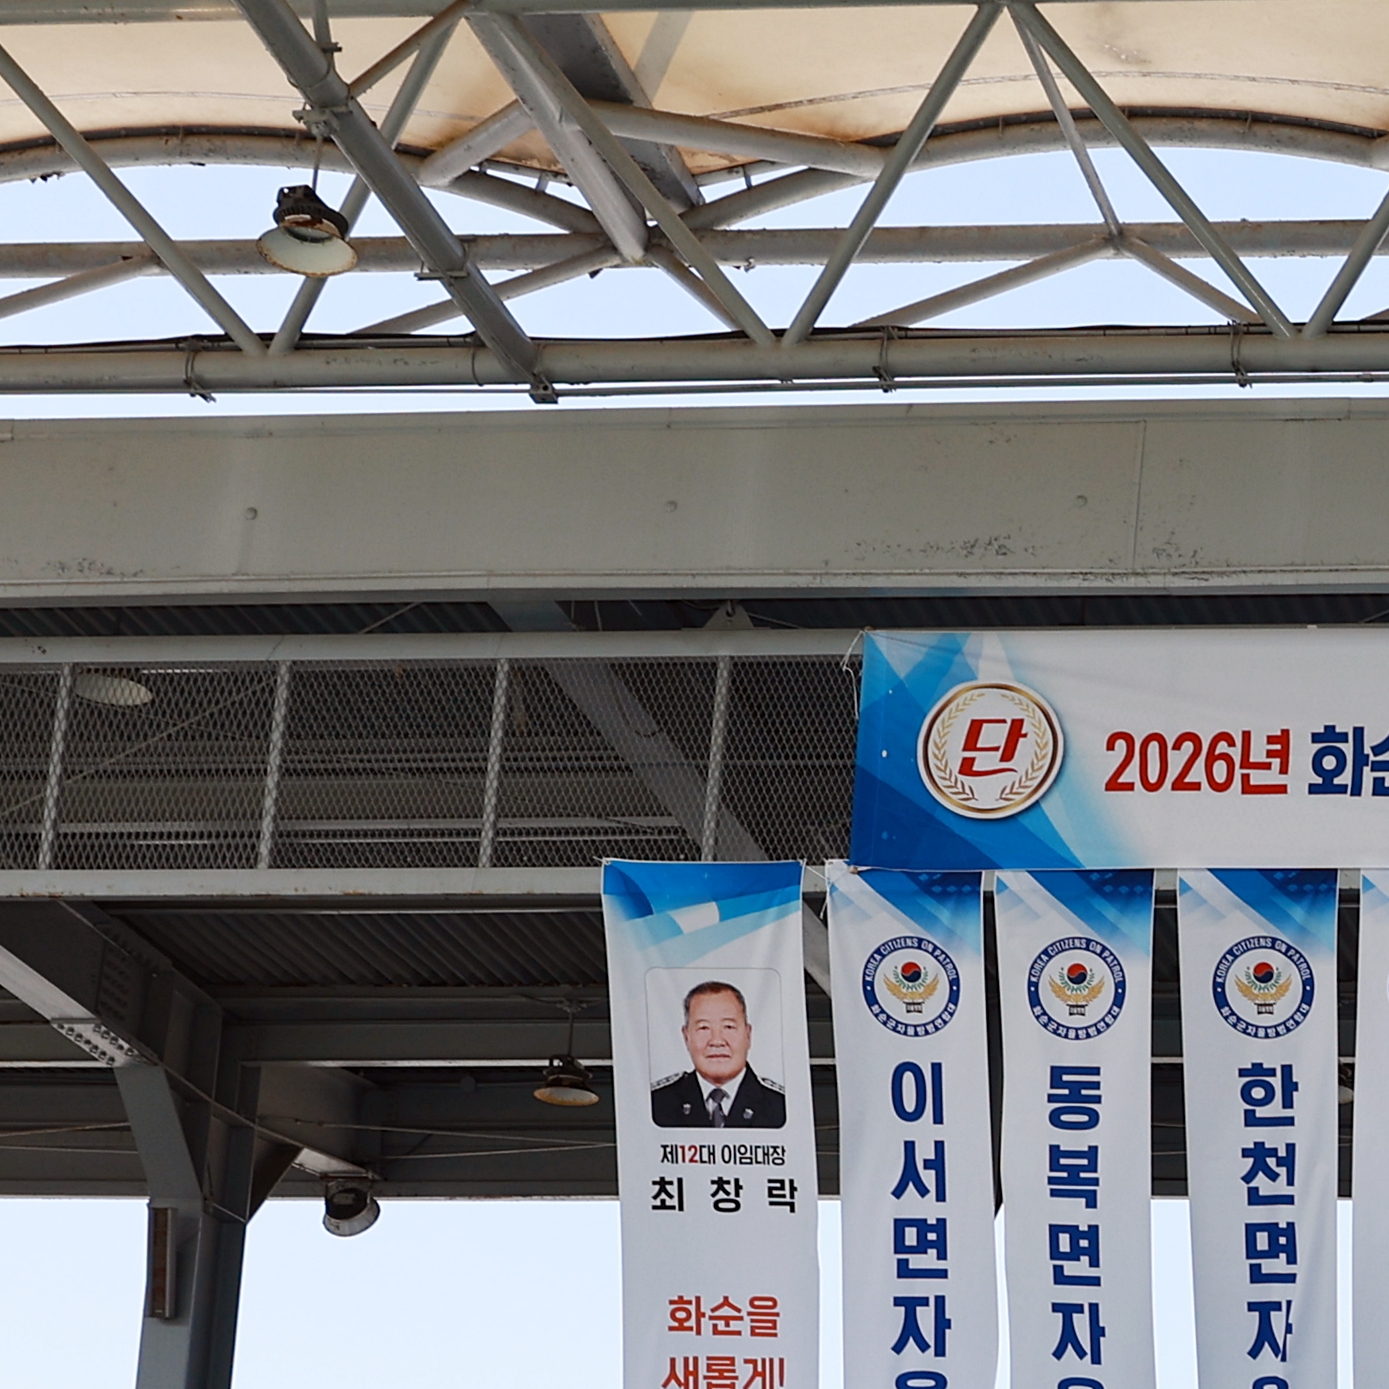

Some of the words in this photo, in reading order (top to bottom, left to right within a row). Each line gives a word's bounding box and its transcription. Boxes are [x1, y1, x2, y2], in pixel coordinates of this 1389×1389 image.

[958, 718, 1027, 772] 단
[1105, 729, 1290, 795] 2026년
[661, 1144, 716, 1164] 제12대
[722, 1145, 785, 1165] 이임대장
[669, 1296, 779, 1337] 화순을
